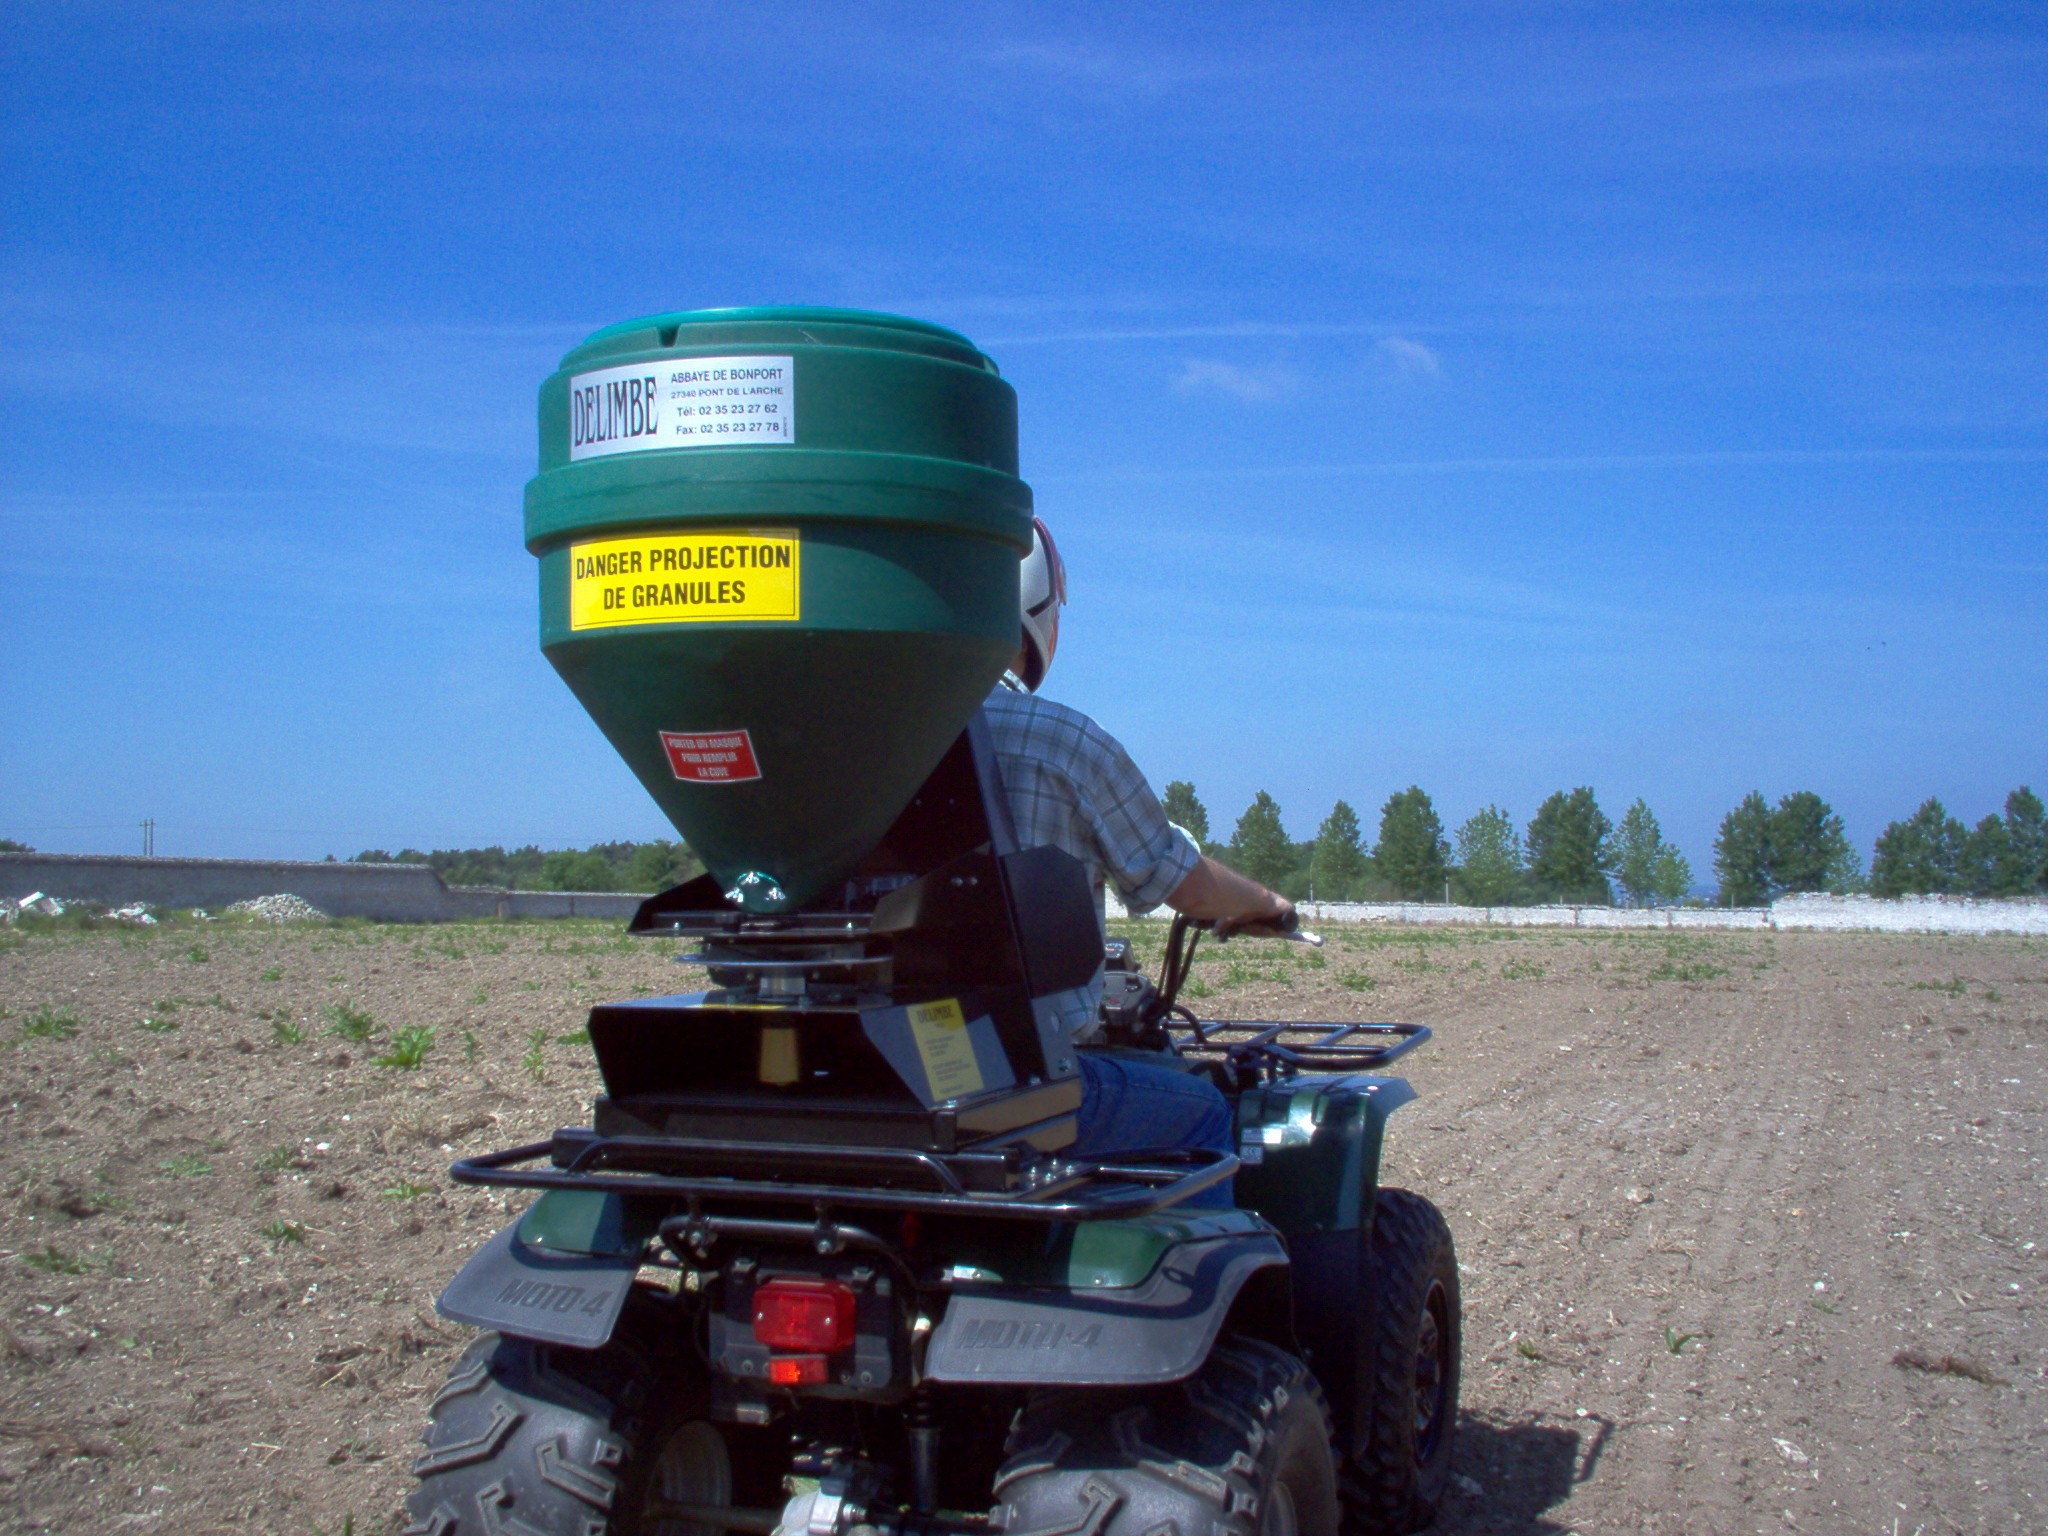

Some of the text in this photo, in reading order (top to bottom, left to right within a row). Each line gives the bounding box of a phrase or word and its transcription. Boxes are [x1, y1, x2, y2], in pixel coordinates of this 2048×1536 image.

[671, 368, 783, 384] ABBAYE DE BONPORT
[698, 388, 724, 397] PONT
[727, 387, 739, 396] DE
[574, 377, 658, 447] DELIMBE
[699, 406, 711, 416] 02
[715, 405, 728, 415] 35
[731, 404, 745, 414] 23
[747, 404, 760, 414] 27
[764, 403, 778, 413] 62
[676, 425, 697, 435] Fax:
[700, 424, 713, 434] 02
[716, 423, 729, 433] 35
[733, 422, 746, 432] 23
[749, 422, 762, 432] 27
[766, 422, 779, 432] 78
[576, 544, 791, 580] DANGER PROJECTION
[603, 580, 746, 610] DE GRANULES
